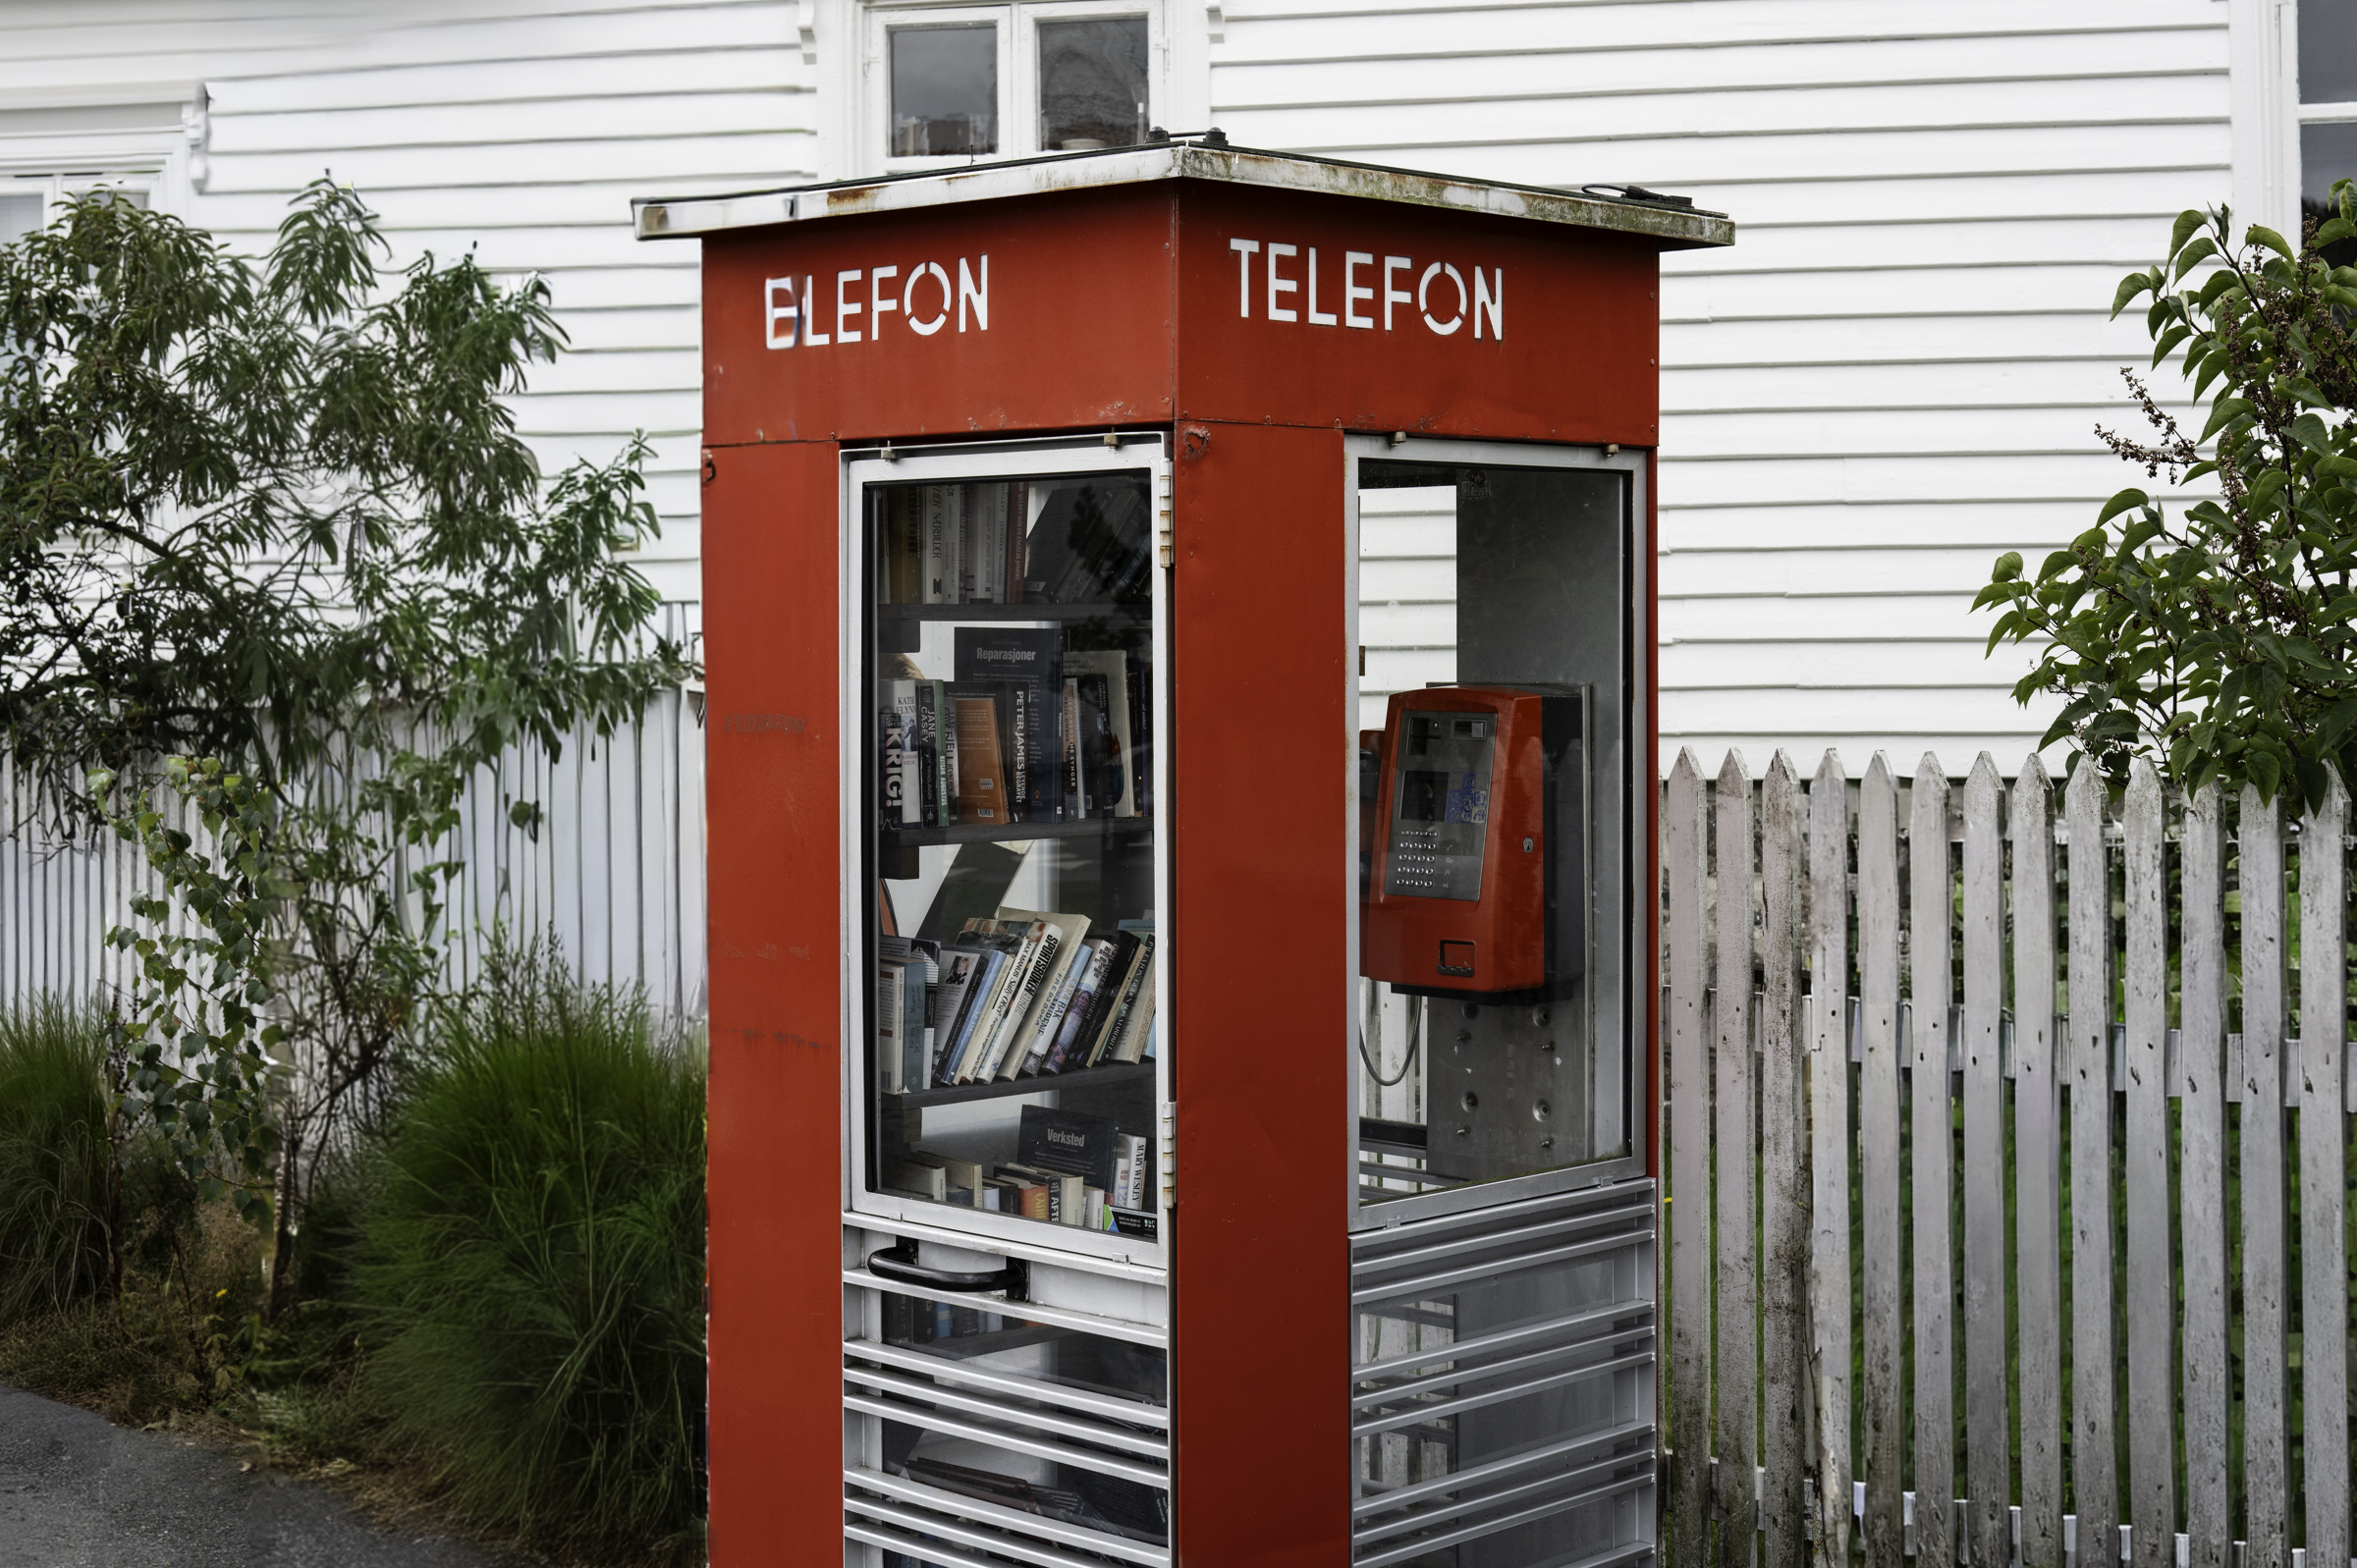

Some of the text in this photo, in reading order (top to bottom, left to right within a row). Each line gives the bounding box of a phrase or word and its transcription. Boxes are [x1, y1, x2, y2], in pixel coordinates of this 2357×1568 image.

[1230, 238, 1504, 342] TELEFON
[933, 513, 943, 559] NÆRBILDER
[986, 533, 992, 542] AV
[986, 560, 992, 569] OG
[977, 647, 1037, 664] Reparasjoner
[898, 697, 916, 706] KATIE
[920, 706, 929, 743] CASEY
[1014, 691, 1026, 771] PETER JAMES
[885, 729, 904, 808] KRIG!
[1023, 933, 1060, 996] SPORTSBOKEN
[1107, 944, 1120, 961] DEN
[1014, 954, 1027, 978] MANUS
[1096, 960, 1111, 986] SORTE
[1005, 980, 1016, 996] Sally
[1035, 973, 1063, 1026] FREDSBOKA
[1060, 976, 1077, 1000] SARA
[1051, 1000, 1067, 1019] BAK
[1085, 986, 1102, 1020] BRUDEN
[1145, 994, 1156, 1016] SISTE
[974, 1052, 984, 1066] Puerto
[1047, 1128, 1086, 1148] Verksted
[1132, 1170, 1143, 1203] WESLEY
